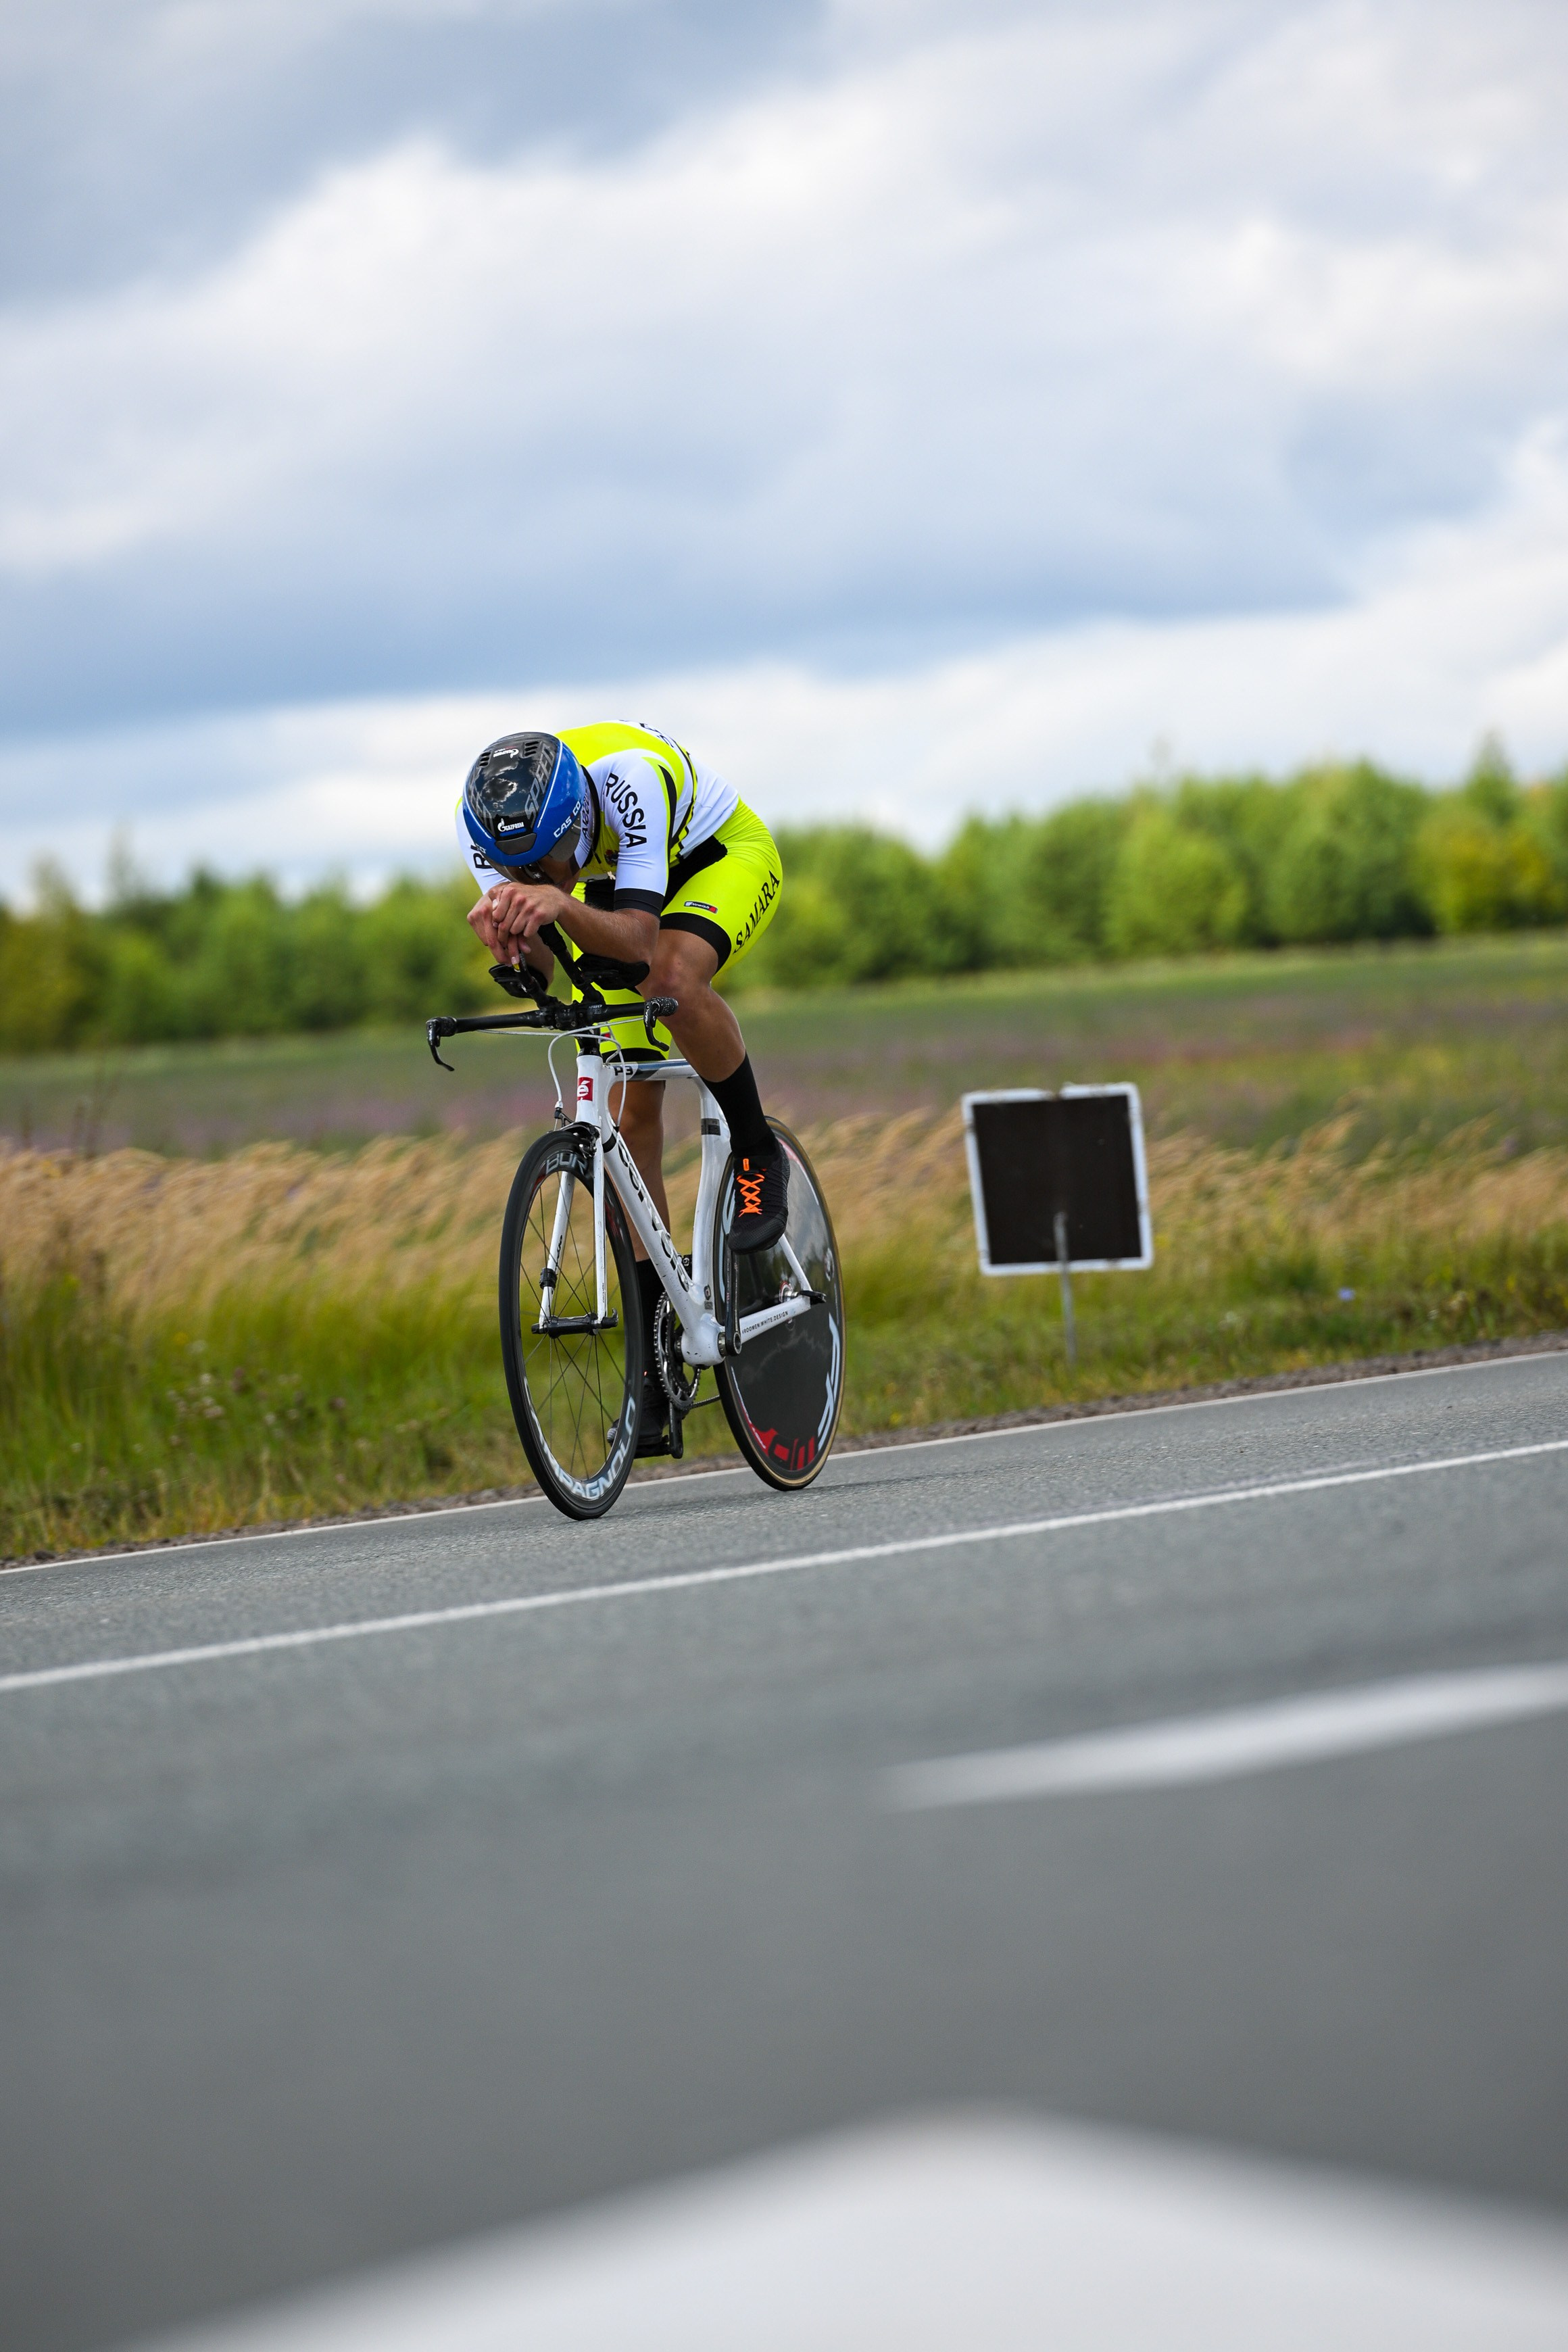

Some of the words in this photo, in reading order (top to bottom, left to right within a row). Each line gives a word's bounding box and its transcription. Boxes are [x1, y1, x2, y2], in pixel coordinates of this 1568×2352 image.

[605, 773, 647, 848] RUSSIA
[732, 870, 780, 954] SAMARA
[613, 1065, 633, 1076] P3
